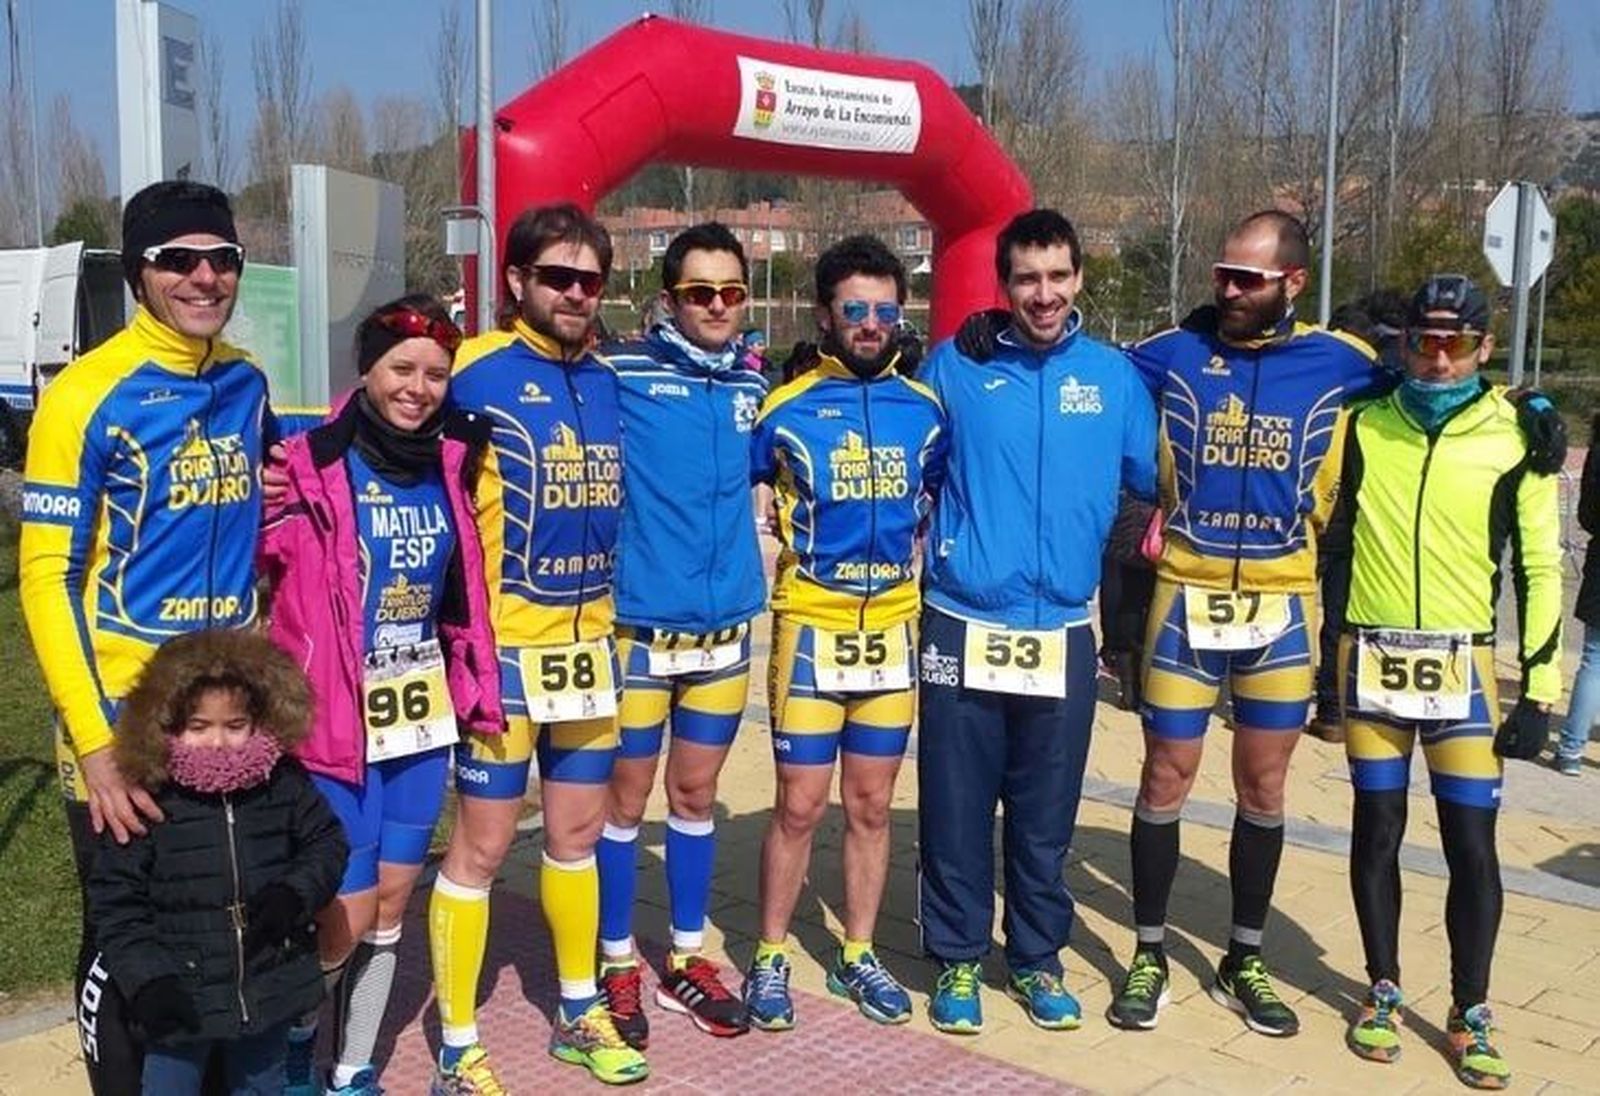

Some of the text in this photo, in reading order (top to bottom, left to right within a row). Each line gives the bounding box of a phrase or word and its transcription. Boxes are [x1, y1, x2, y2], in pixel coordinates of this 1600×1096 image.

[784, 98, 820, 121] Arroyo
[823, 104, 836, 120] de
[839, 105, 852, 121] La
[1202, 444, 1292, 471] DUERO
[22, 490, 82, 519] MORA
[371, 504, 449, 538] MATILLA
[389, 537, 436, 569] ESP
[158, 595, 243, 621] ZAMOR
[374, 604, 430, 622] DUERO
[1207, 587, 1261, 625] 57
[834, 633, 887, 667] 55
[984, 632, 1042, 670] 53
[541, 653, 595, 691] 58
[1380, 656, 1443, 692] 56
[367, 680, 431, 729] 96
[80, 951, 109, 1063] SCOT
